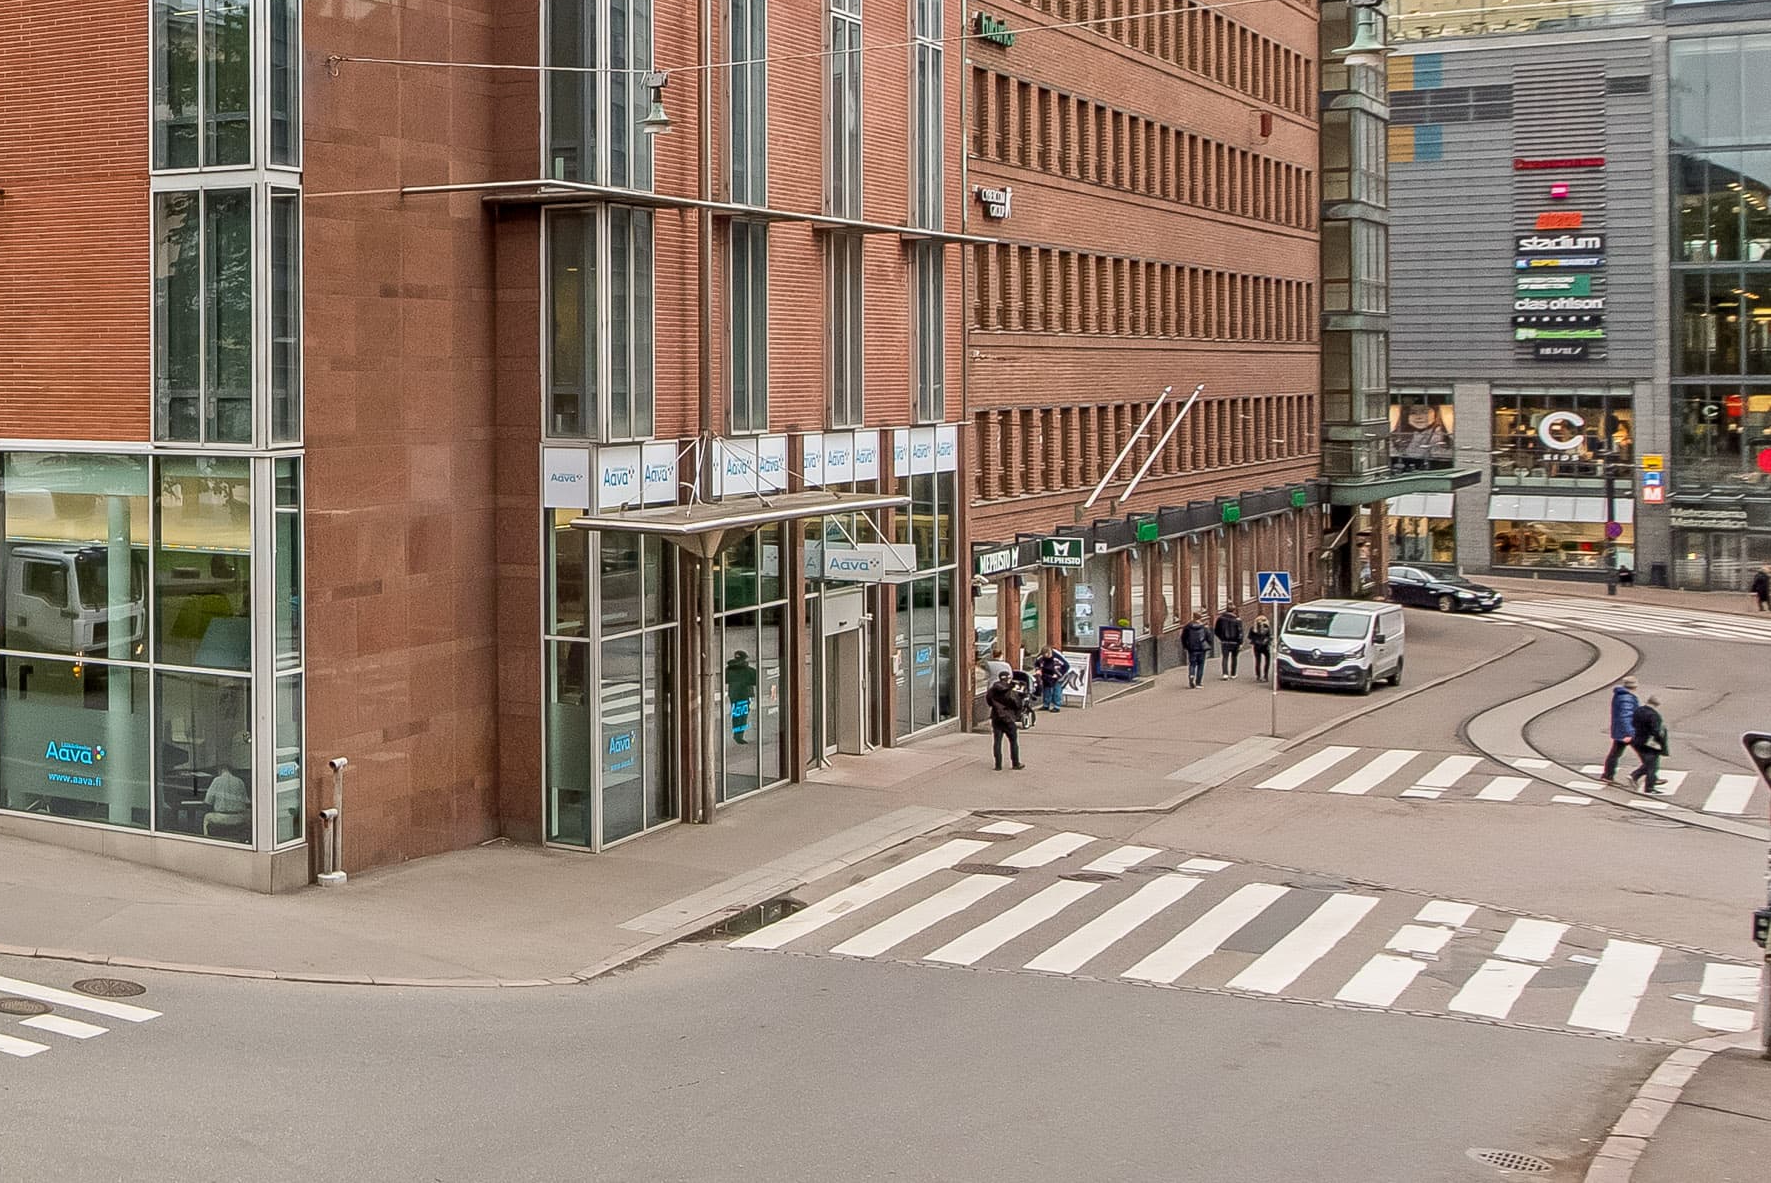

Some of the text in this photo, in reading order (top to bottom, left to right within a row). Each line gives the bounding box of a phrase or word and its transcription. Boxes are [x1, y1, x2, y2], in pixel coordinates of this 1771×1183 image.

[1518, 235, 1601, 251] stadium
[1513, 297, 1603, 311] clas ohlson
[828, 450, 846, 466] Aava
[855, 448, 873, 463] Aava
[550, 472, 577, 483] Aava
[603, 467, 629, 487] Aava
[644, 463, 668, 483] Aava
[829, 557, 870, 571] Aava
[979, 549, 1011, 575] MEPHISTO
[1042, 555, 1081, 565] MEPHISTO
[45, 740, 93, 765] Aava
[609, 737, 630, 755] Aava
[47, 772, 102, 787] www.aava.fi
